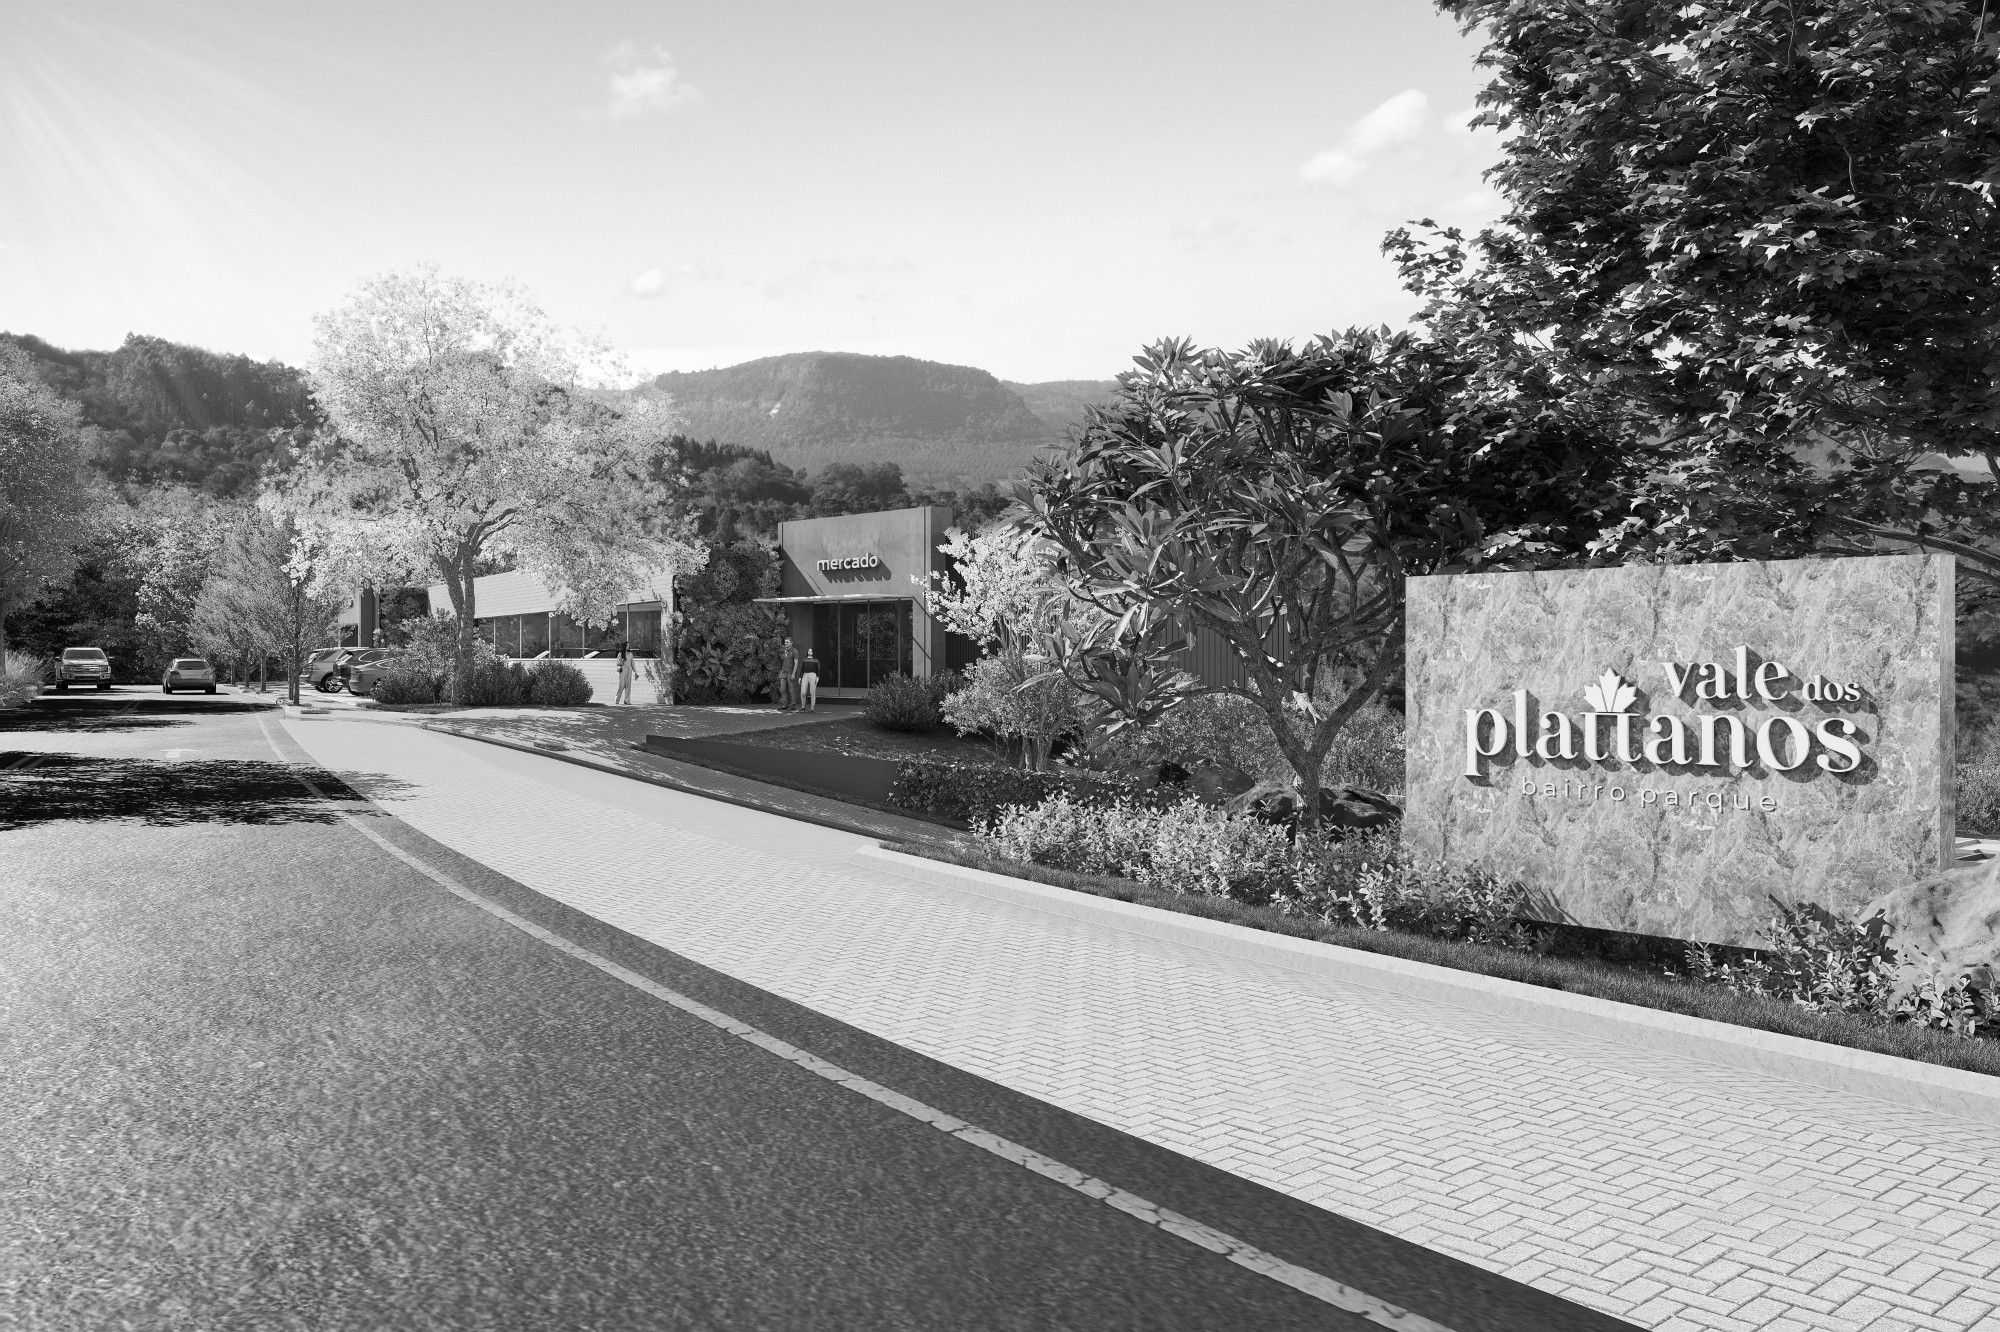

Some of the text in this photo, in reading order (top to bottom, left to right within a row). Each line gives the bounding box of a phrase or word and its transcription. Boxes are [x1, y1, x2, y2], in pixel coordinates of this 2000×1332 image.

[816, 552, 878, 571] mercado
[1662, 645, 1861, 702] vale dos
[1463, 688, 1863, 777] plattanos
[1521, 776, 1778, 813] bairro parque
